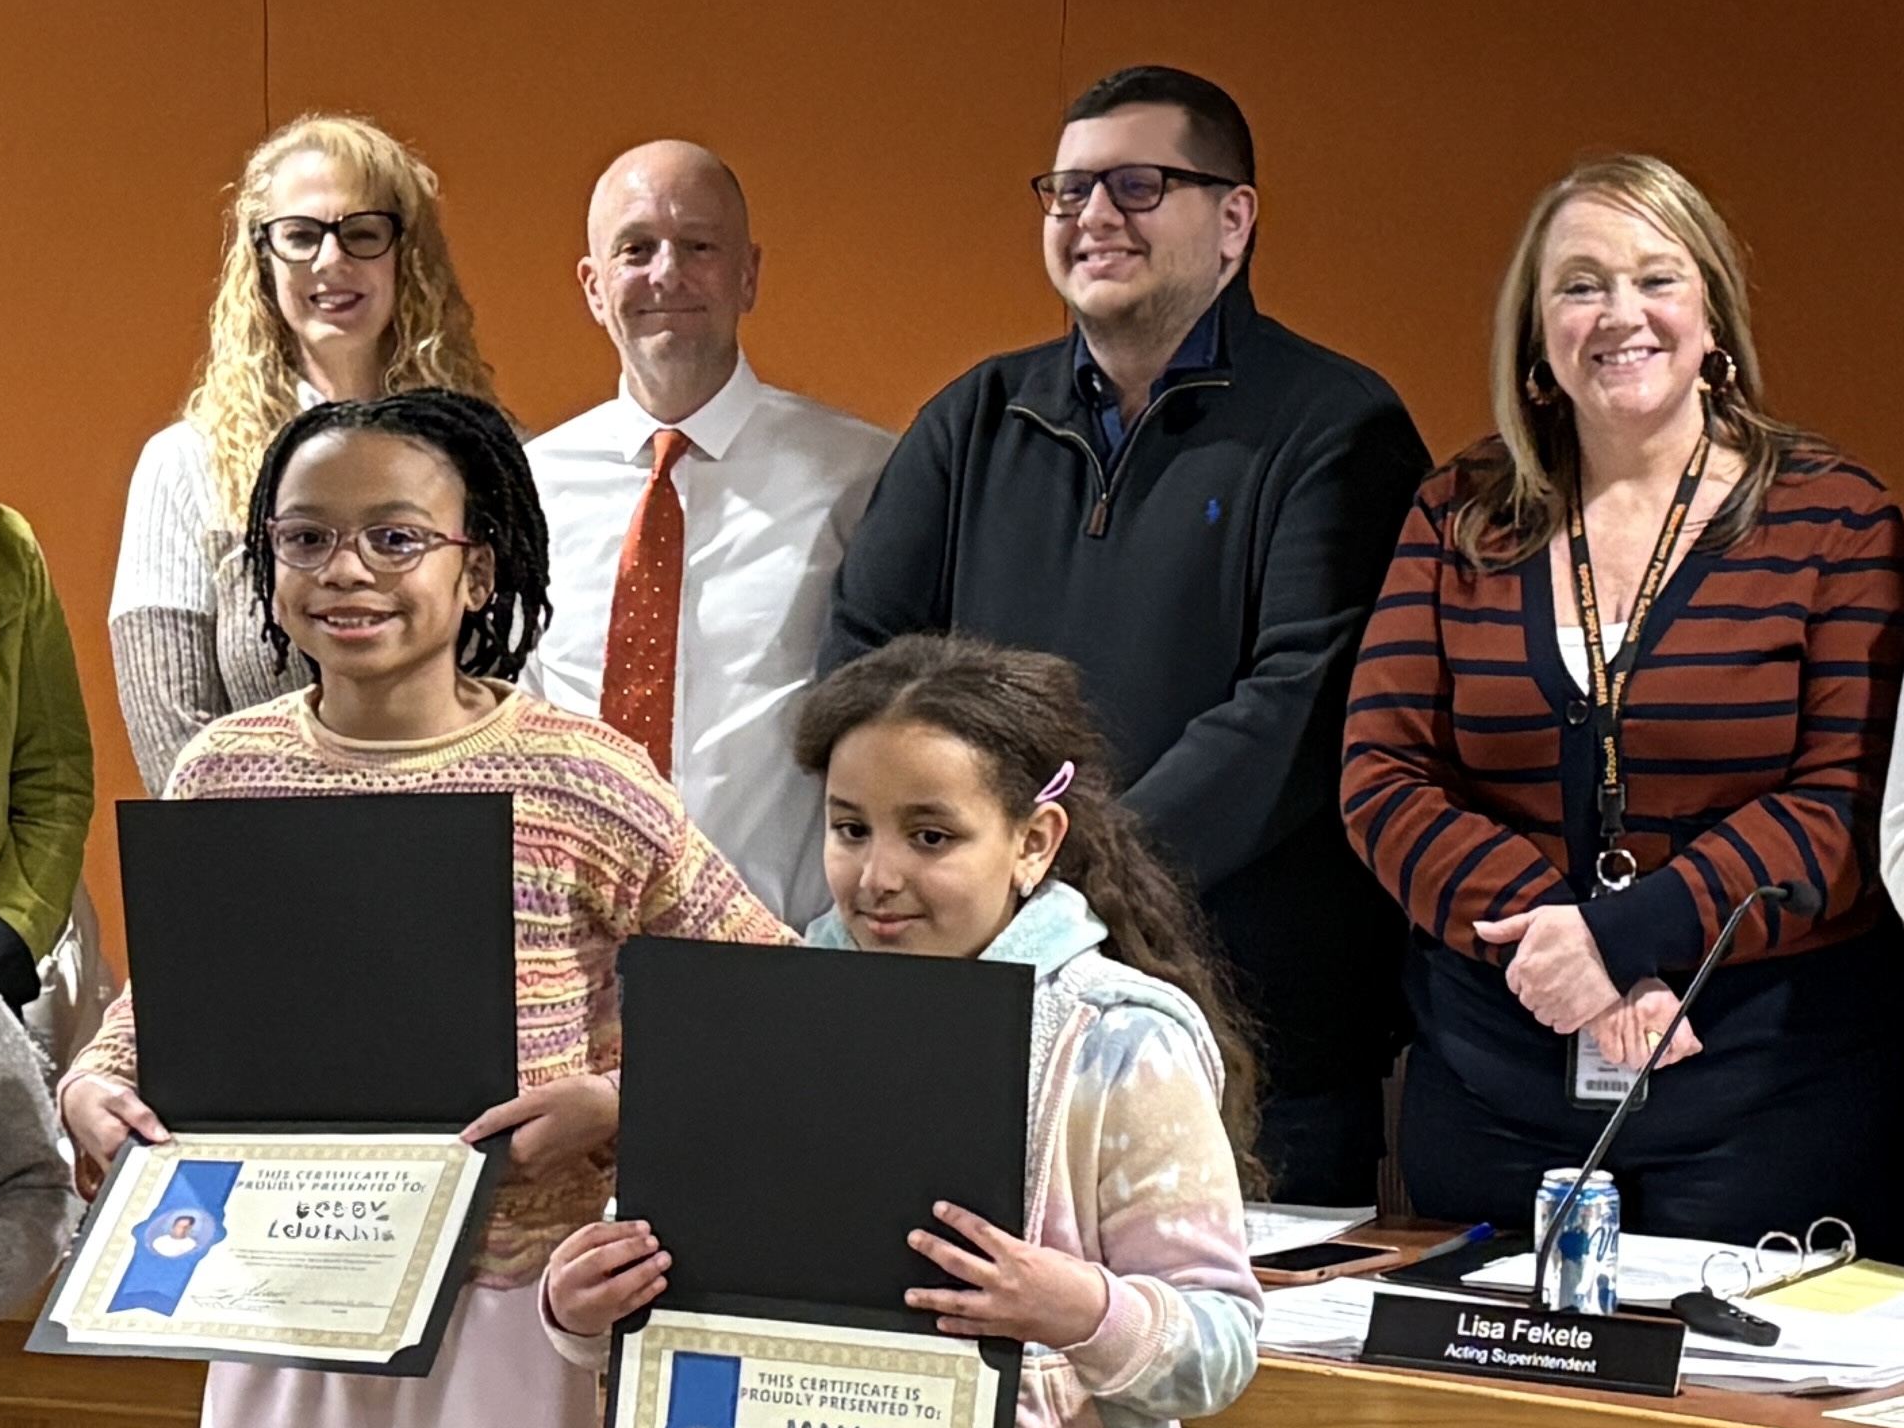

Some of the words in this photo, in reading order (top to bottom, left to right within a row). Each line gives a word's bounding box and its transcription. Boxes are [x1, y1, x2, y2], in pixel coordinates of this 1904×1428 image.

[1457, 1312, 1506, 1340] Lisa
[1512, 1318, 1593, 1349] Fekete
[1444, 1343, 1488, 1364] Acting
[1491, 1347, 1598, 1374] Superintendent
[758, 1372, 795, 1390] THIS
[800, 1376, 900, 1399] CERTIFICATE
[905, 1386, 923, 1402] IS
[741, 1387, 815, 1407] PROUDLY
[818, 1395, 910, 1417] PRESENTED
[914, 1403, 943, 1422] TO:
